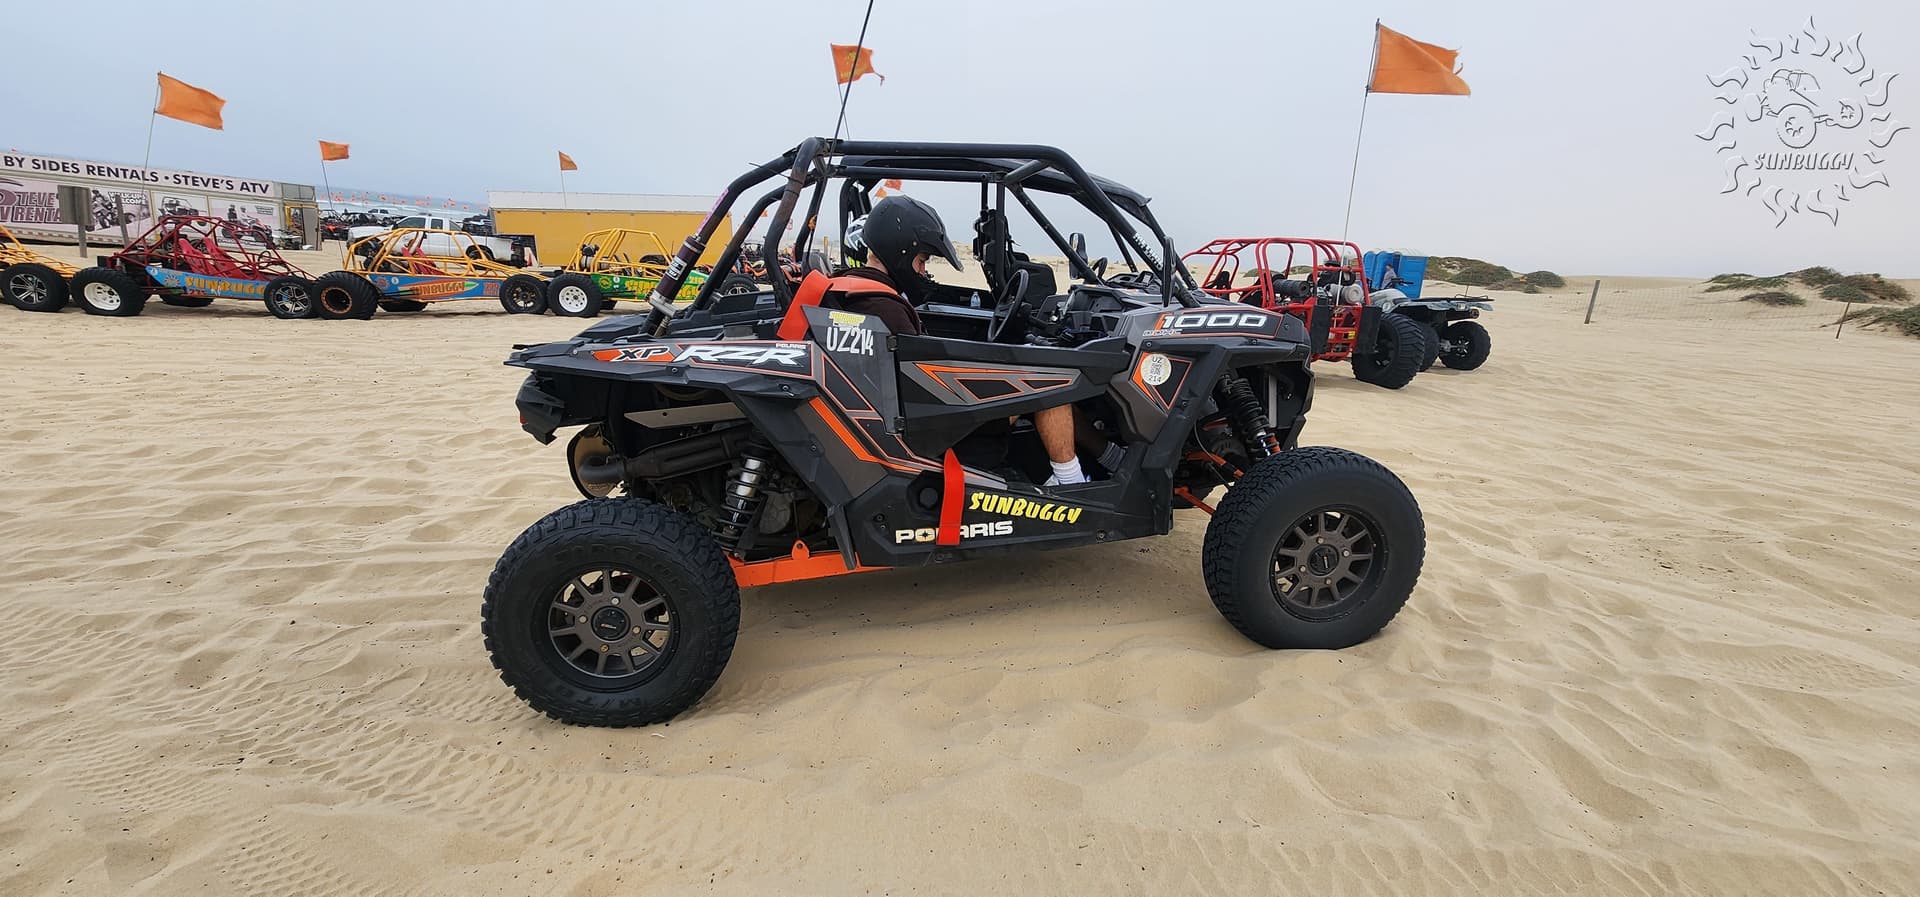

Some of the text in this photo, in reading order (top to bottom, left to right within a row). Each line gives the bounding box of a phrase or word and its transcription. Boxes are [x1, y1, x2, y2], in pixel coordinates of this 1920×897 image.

[4, 156, 269, 194] BY SIDES RENTALS STEVE'S ATV
[12, 206, 62, 223] RENTA
[185, 276, 265, 294] SUNBUGG
[1162, 313, 1267, 329] 1000
[826, 326, 874, 356] UZ214
[610, 344, 806, 366] XP RZR
[968, 492, 1082, 524] SUNBUGGY
[895, 520, 1013, 544] POARIS
